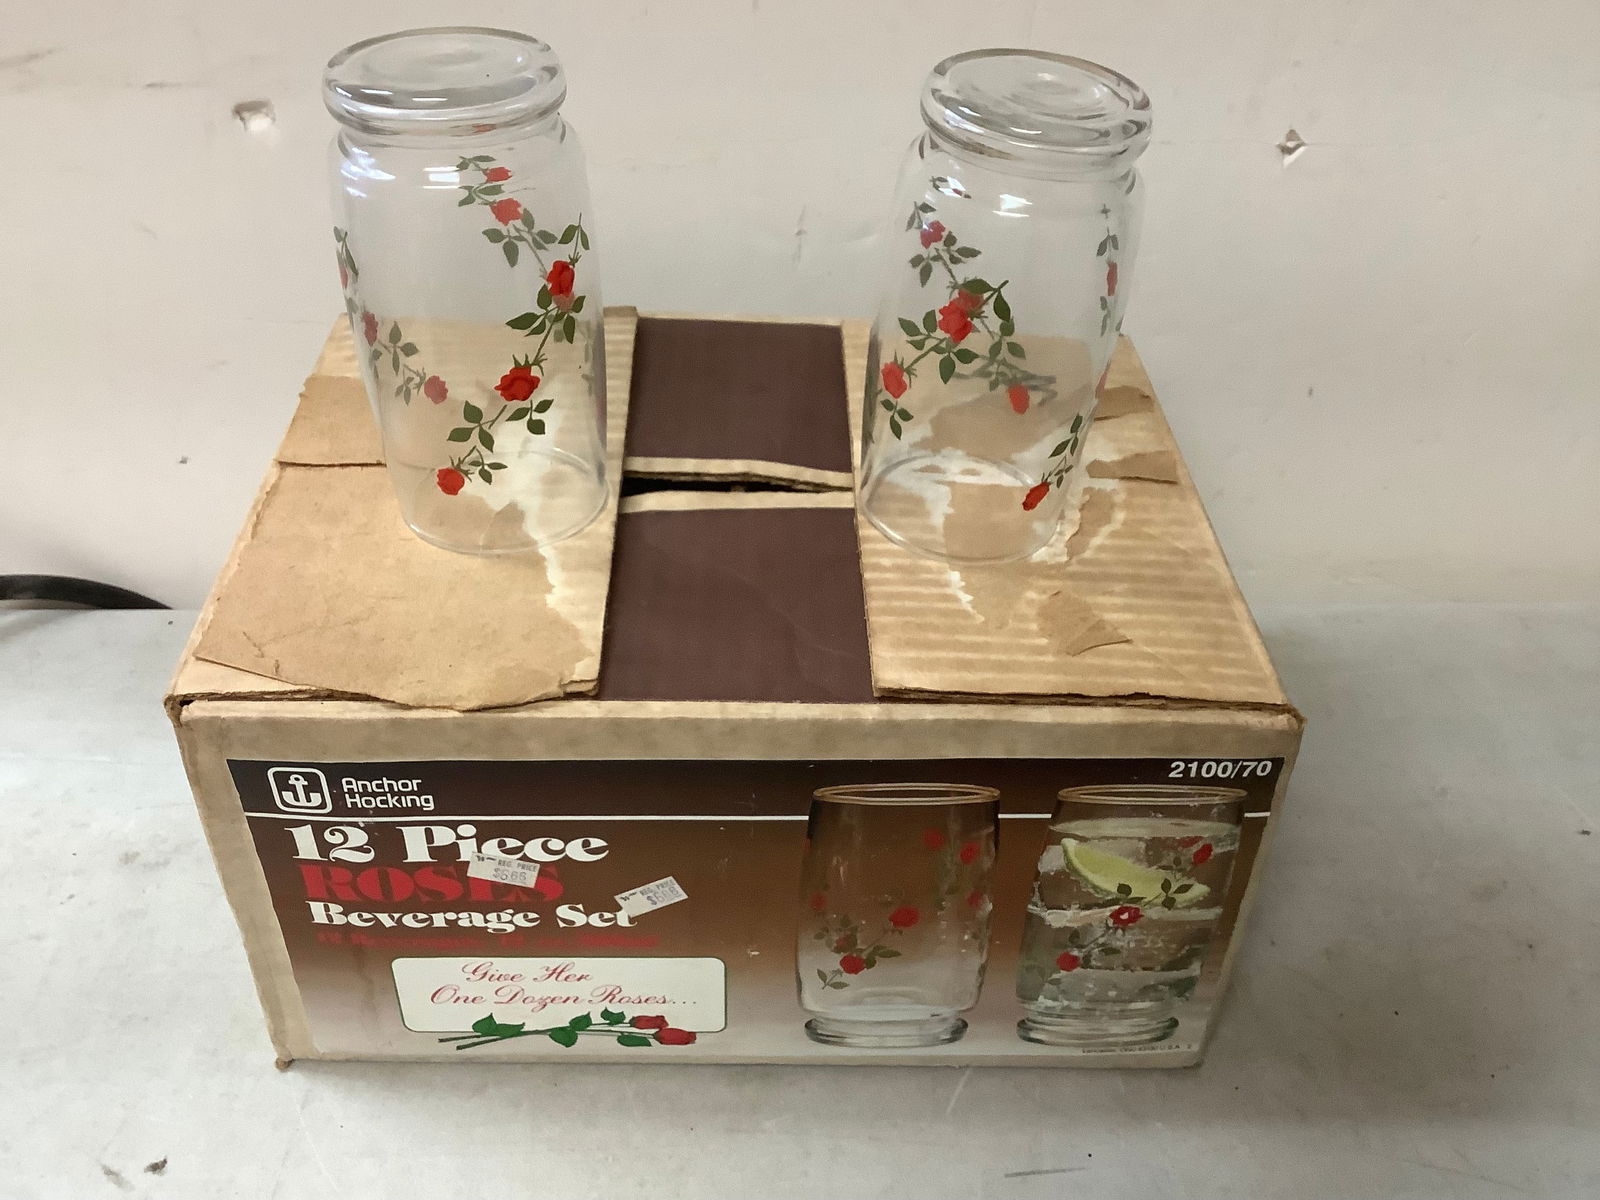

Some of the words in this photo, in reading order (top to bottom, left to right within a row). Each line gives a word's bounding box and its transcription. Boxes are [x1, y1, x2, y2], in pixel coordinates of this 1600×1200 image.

[1168, 760, 1273, 778] 2100/70
[341, 777, 422, 793] Anchor
[345, 792, 435, 811] Hocking
[283, 823, 375, 863] 12
[396, 823, 610, 863] Piece
[305, 901, 541, 934] Beverage
[555, 904, 638, 929] Set
[461, 960, 527, 983] Give
[533, 961, 592, 983] Her
[430, 984, 488, 1005] One
[493, 985, 585, 1012] Dozen
